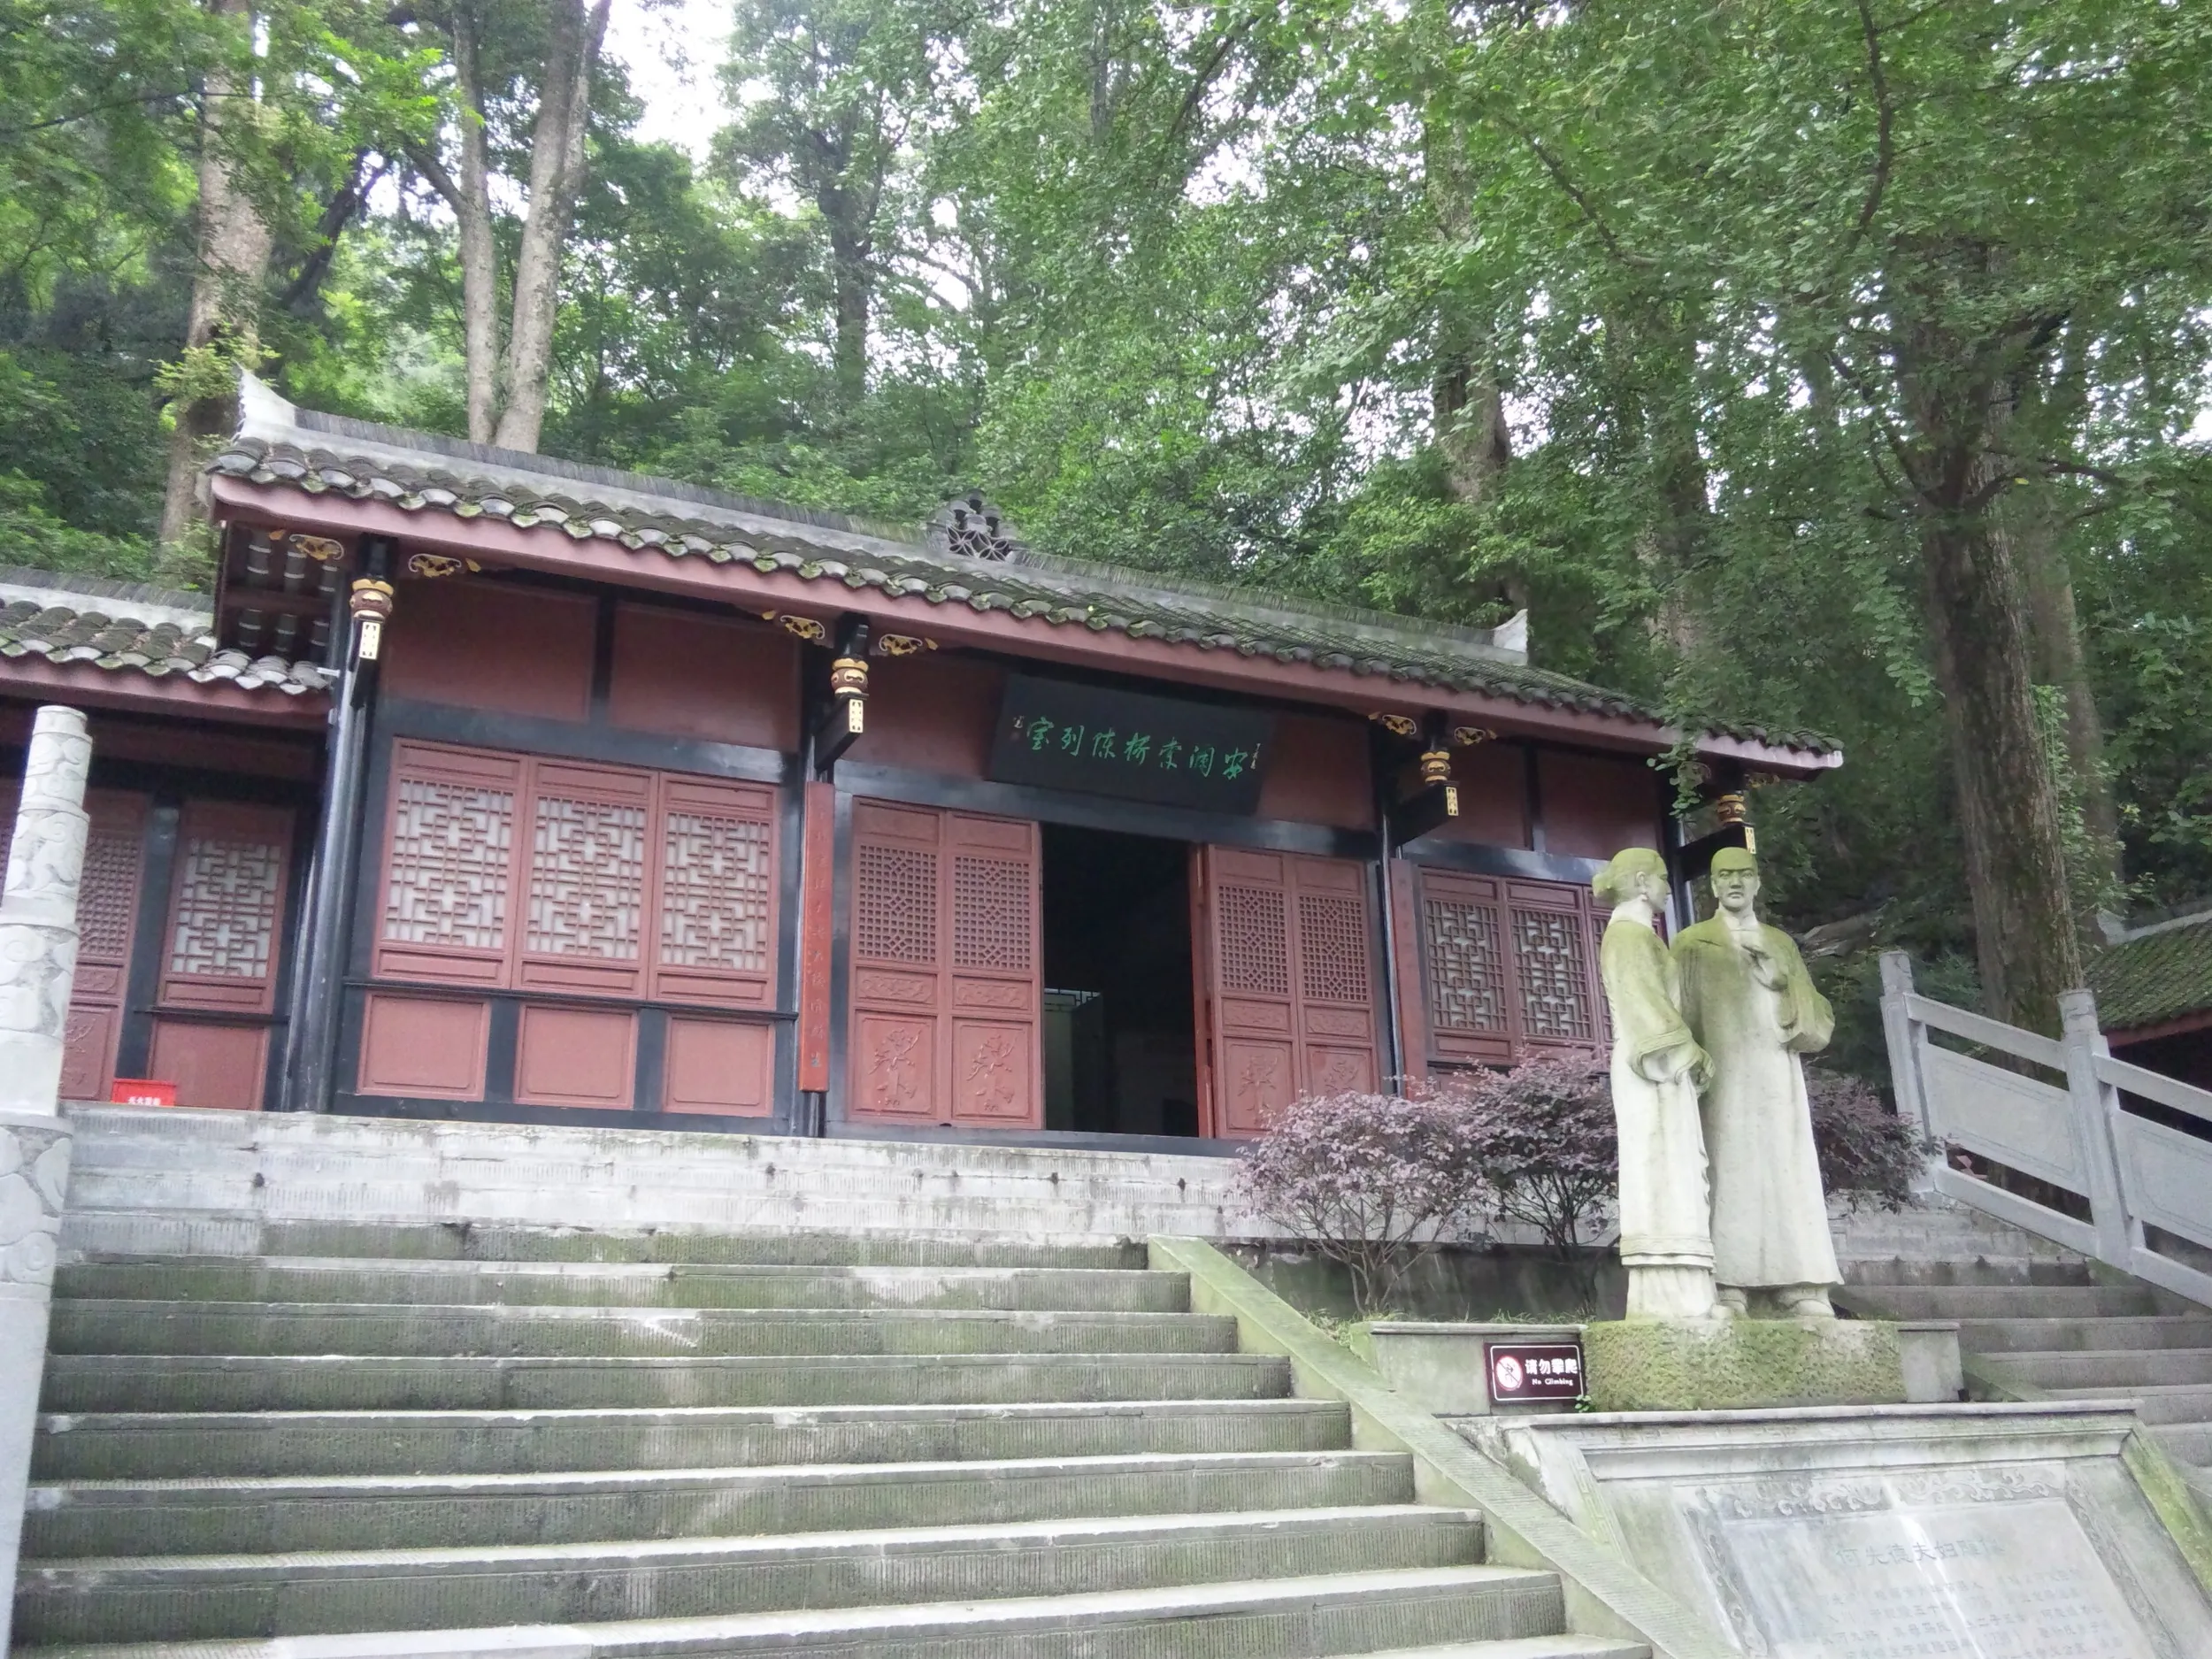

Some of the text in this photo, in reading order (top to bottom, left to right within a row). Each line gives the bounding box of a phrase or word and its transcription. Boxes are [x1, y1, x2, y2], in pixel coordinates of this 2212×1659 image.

[1525, 1357, 1578, 1375] 请勿攀爬
[1545, 1378, 1573, 1386] Climbing
